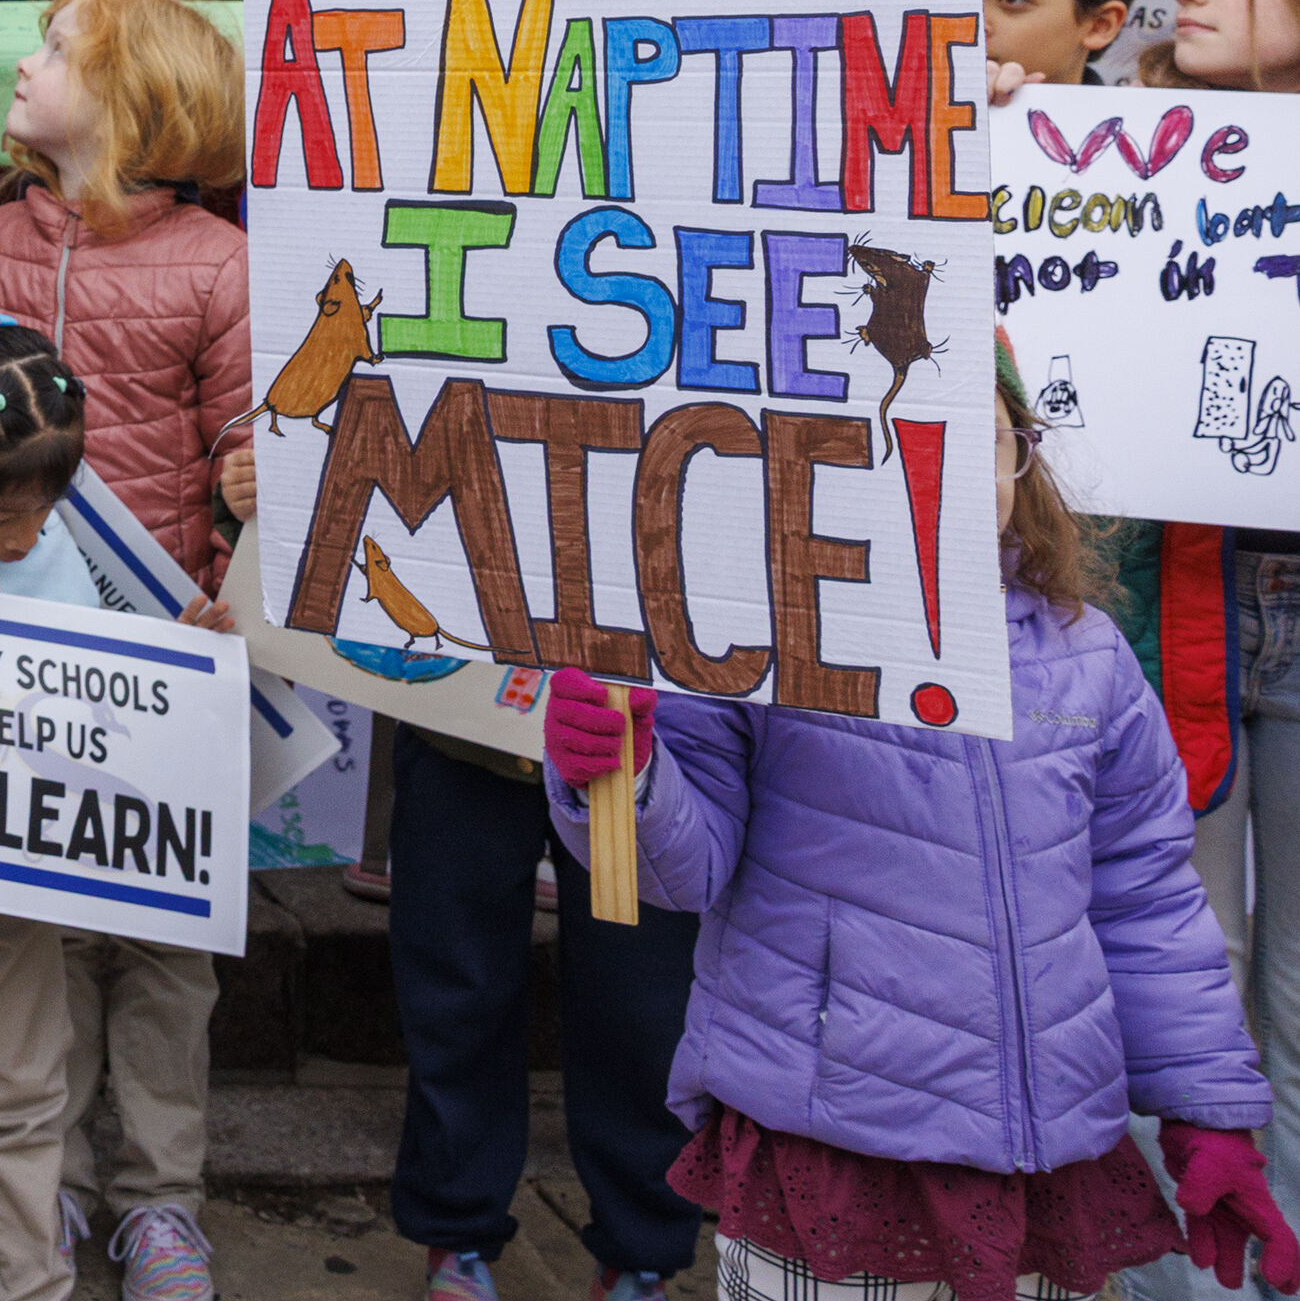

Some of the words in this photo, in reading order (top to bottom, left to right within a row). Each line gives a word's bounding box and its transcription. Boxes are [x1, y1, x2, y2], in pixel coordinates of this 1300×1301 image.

[1027, 105, 1250, 183] We
[991, 184, 1164, 238] clean
[378, 200, 517, 362] I
[549, 205, 850, 400] SEE
[995, 248, 1119, 316] not
[286, 375, 960, 727] MICE!
[16, 655, 170, 715] SCHOOLS
[67, 721, 108, 762] US
